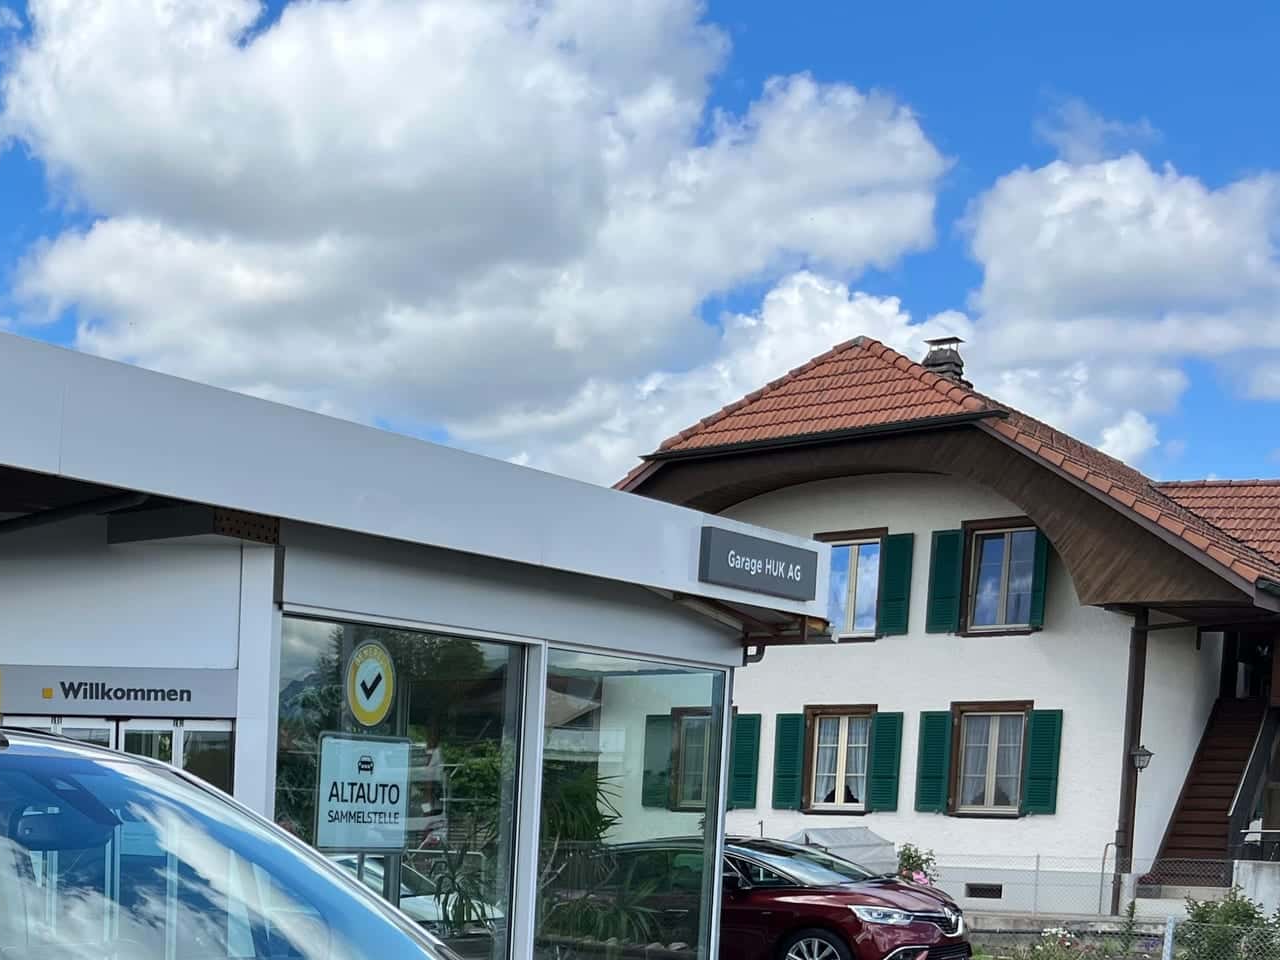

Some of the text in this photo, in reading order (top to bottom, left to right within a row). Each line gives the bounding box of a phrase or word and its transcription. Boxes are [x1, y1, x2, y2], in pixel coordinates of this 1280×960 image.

[727, 549, 801, 581] Garage HUK AG
[59, 680, 193, 703] Willkommen
[328, 780, 401, 805] ALTAUTO
[327, 808, 401, 825] SAMMELSTELLE
